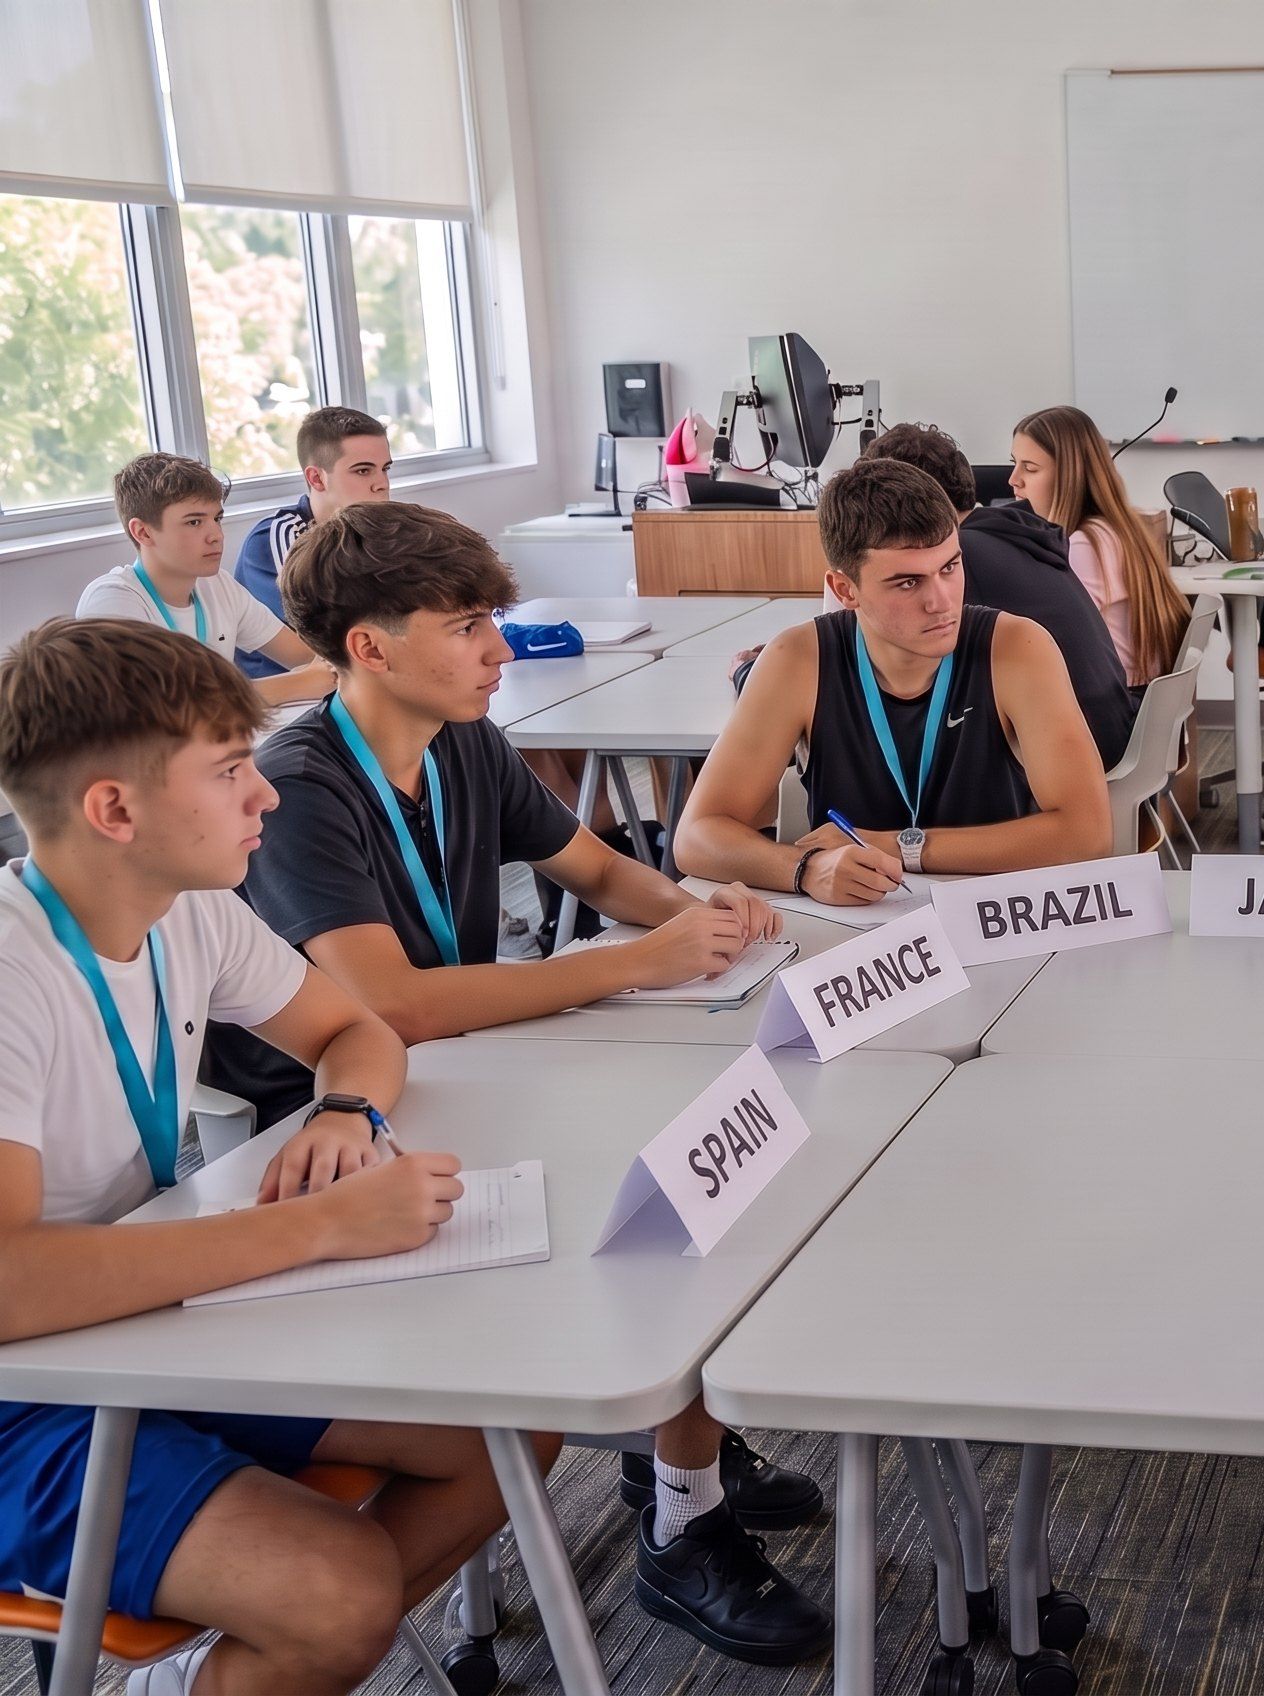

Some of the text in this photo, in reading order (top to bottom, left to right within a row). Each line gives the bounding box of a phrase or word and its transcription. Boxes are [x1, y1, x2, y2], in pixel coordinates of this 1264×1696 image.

[976, 881, 1134, 940] BRAZIL
[812, 935, 942, 1028] FRANCE
[688, 1088, 778, 1199] SPAIN
